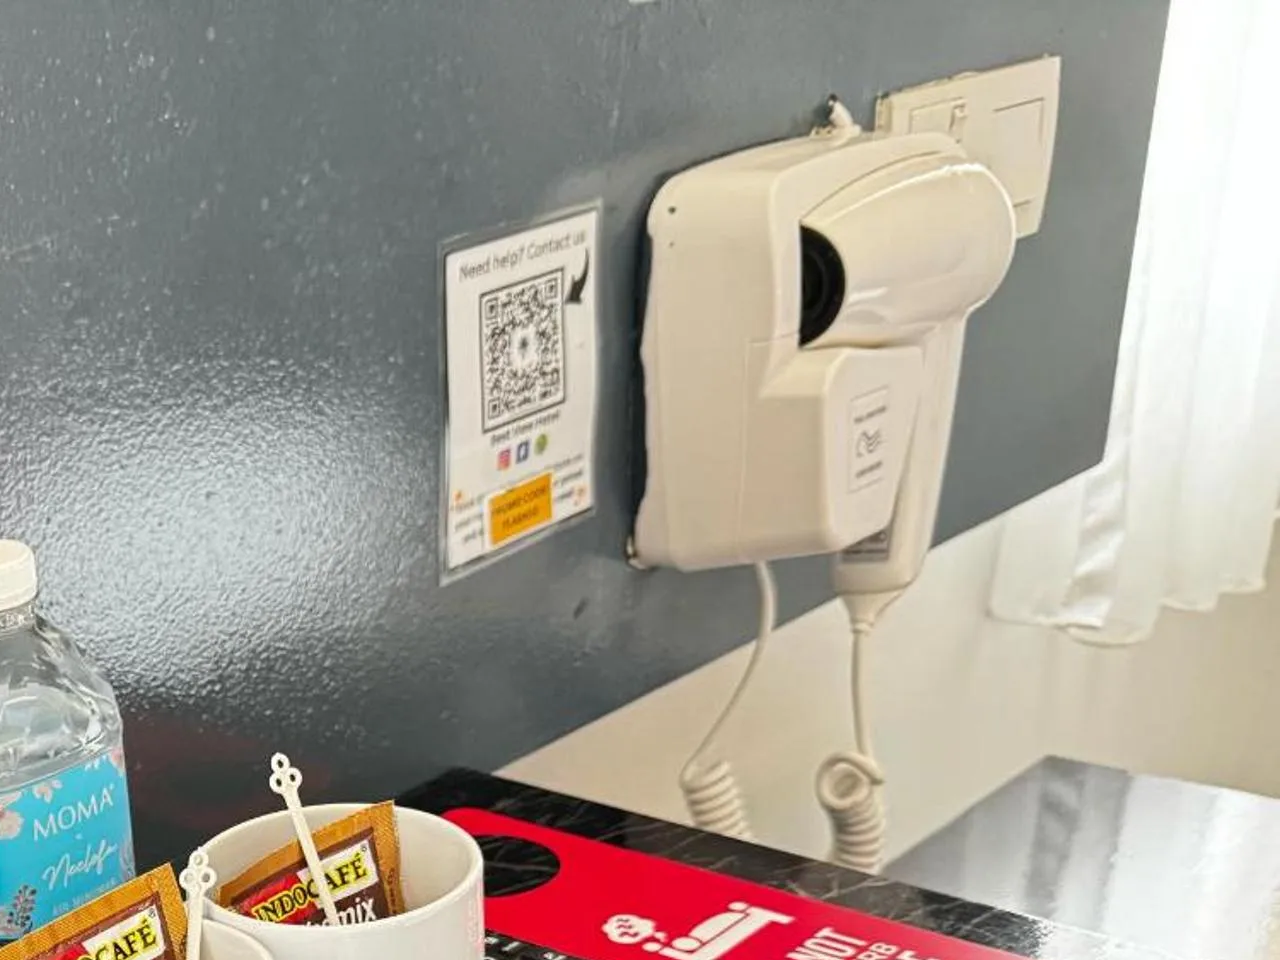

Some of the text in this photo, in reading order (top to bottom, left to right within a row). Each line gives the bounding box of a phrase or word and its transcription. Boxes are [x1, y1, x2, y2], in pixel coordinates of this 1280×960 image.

[459, 230, 586, 282] Need help? Contact us
[34, 787, 114, 841] MOMA
